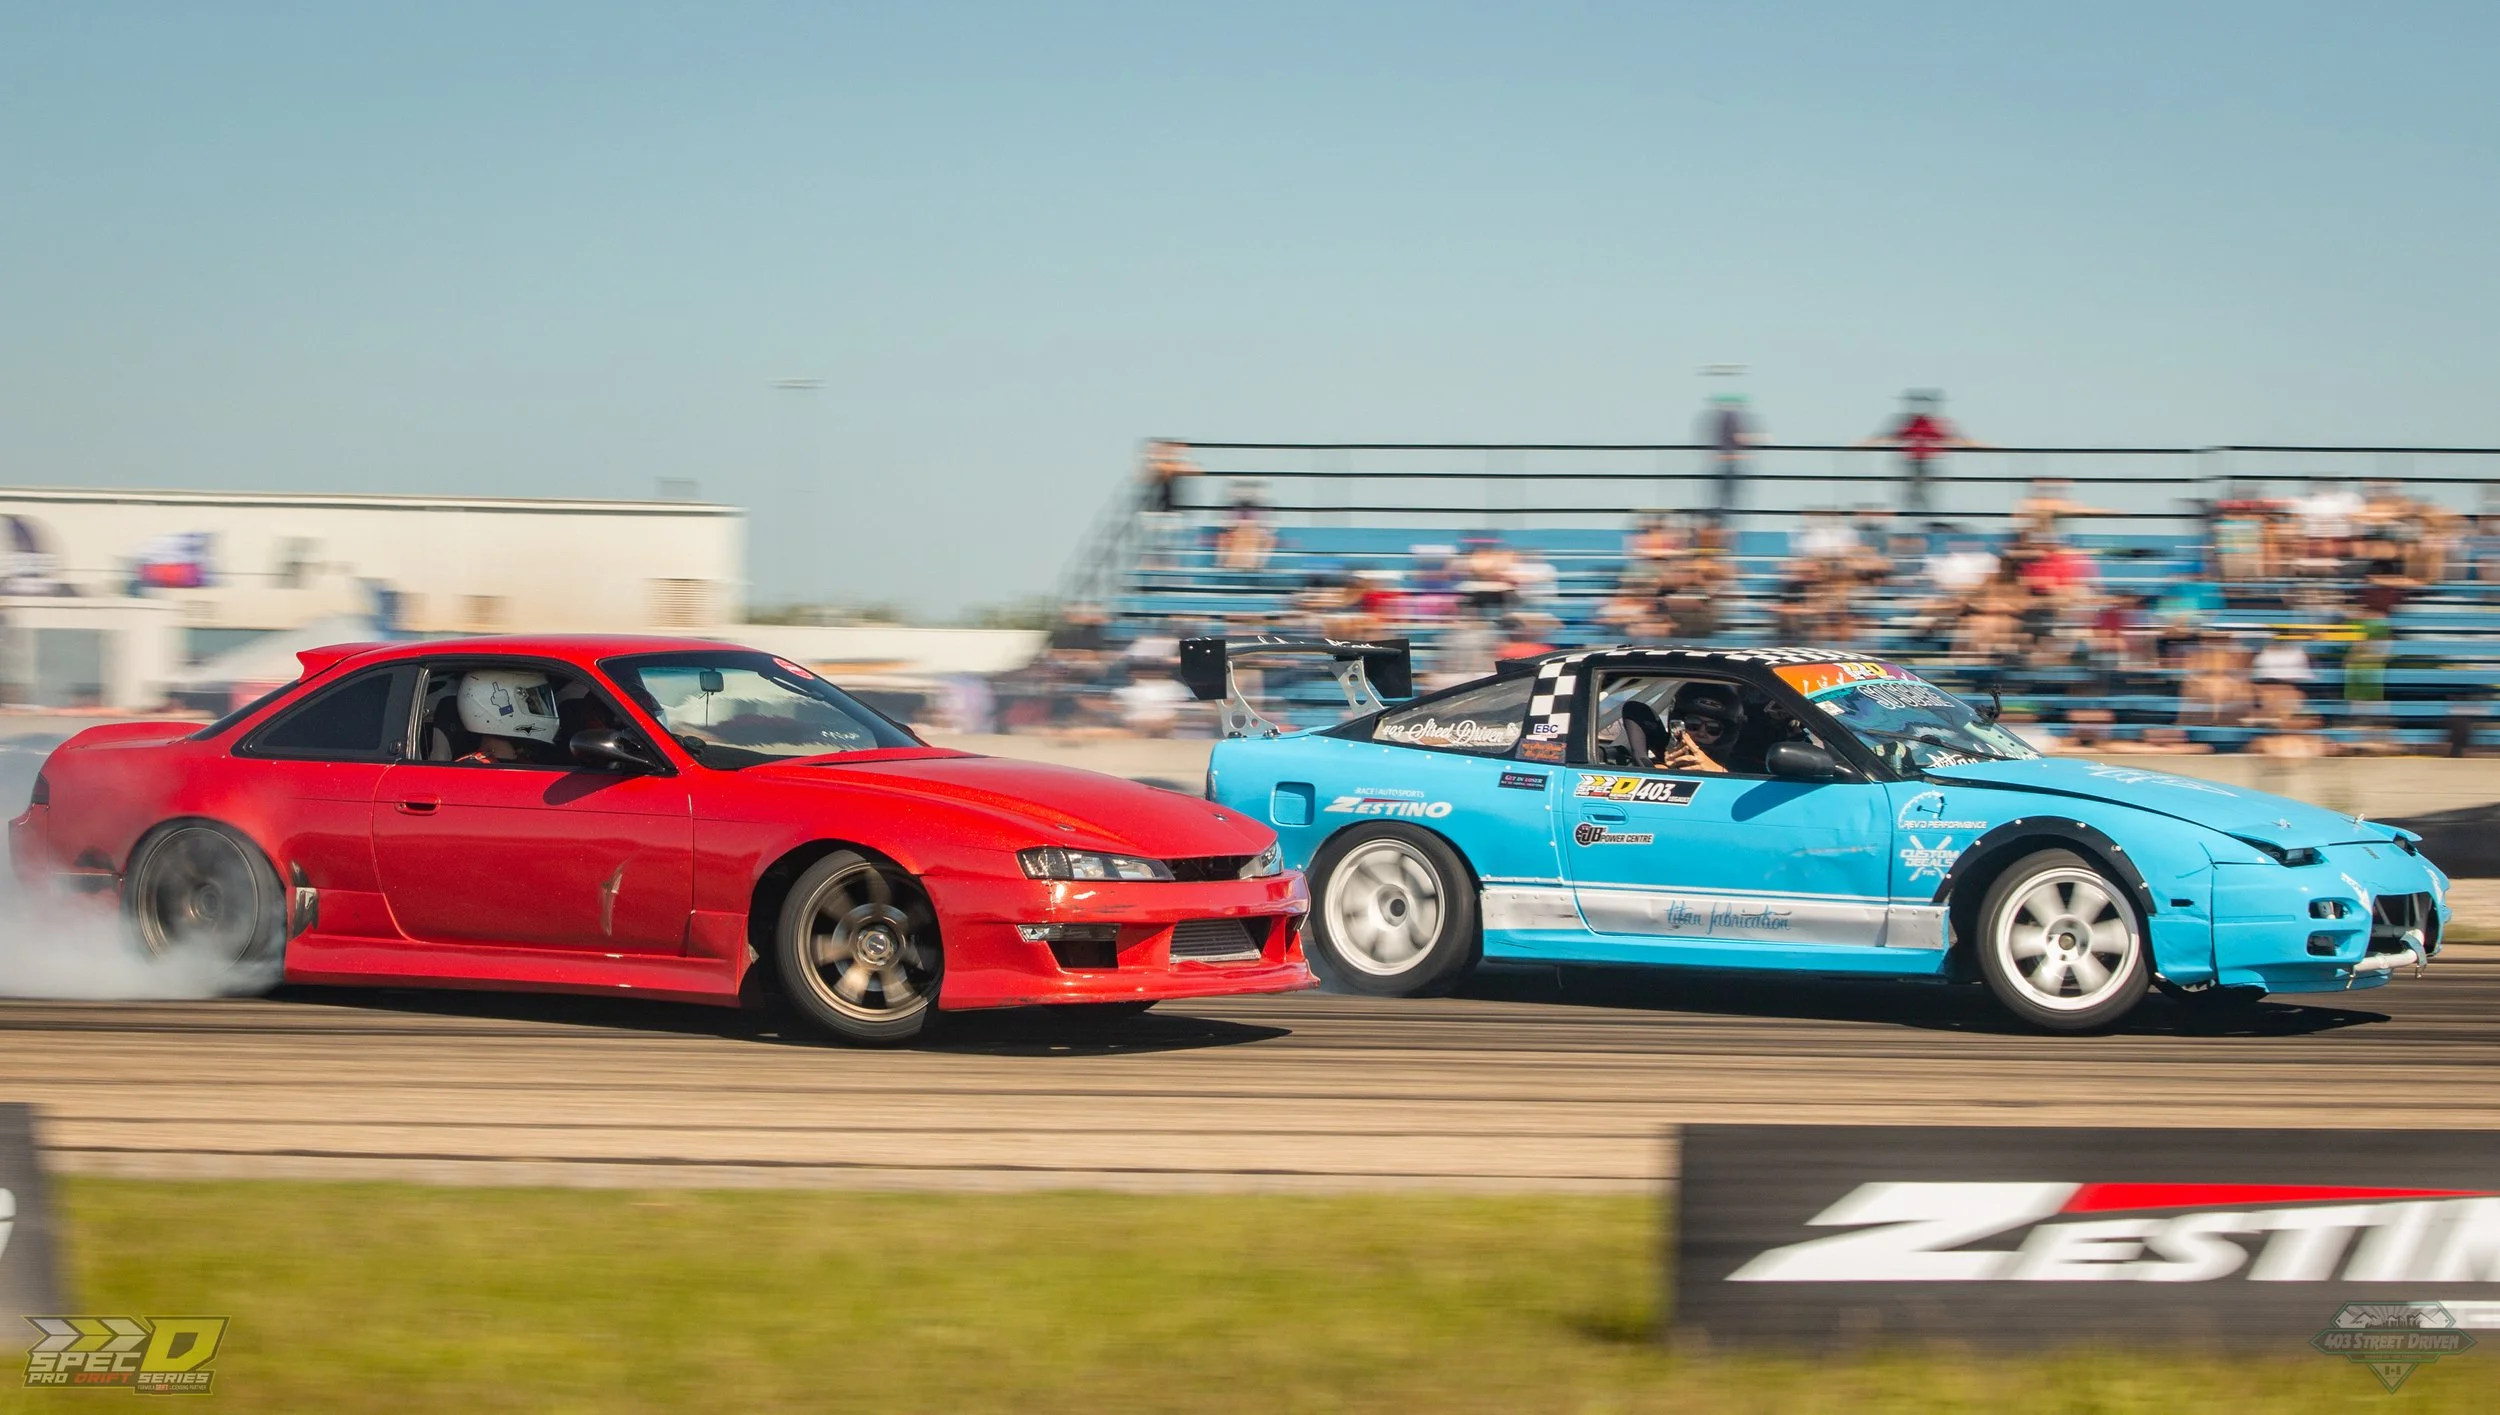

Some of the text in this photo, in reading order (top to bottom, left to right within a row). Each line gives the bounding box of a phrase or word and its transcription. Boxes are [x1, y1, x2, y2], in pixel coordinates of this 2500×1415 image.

[1405, 718, 1455, 742] Street
[1446, 720, 1504, 745] Driven
[1535, 724, 1559, 734] EBC
[1635, 782, 1677, 801] 403
[1323, 796, 1453, 818] ZESTINO
[1928, 821, 1987, 829] PERFORMANCE
[1601, 834, 1626, 843] POWER
[1625, 835, 1653, 843] CENTRE
[1900, 849, 1960, 859] CUSTOM
[1904, 857, 1954, 868] DECALS
[1706, 902, 1792, 935] fabrication
